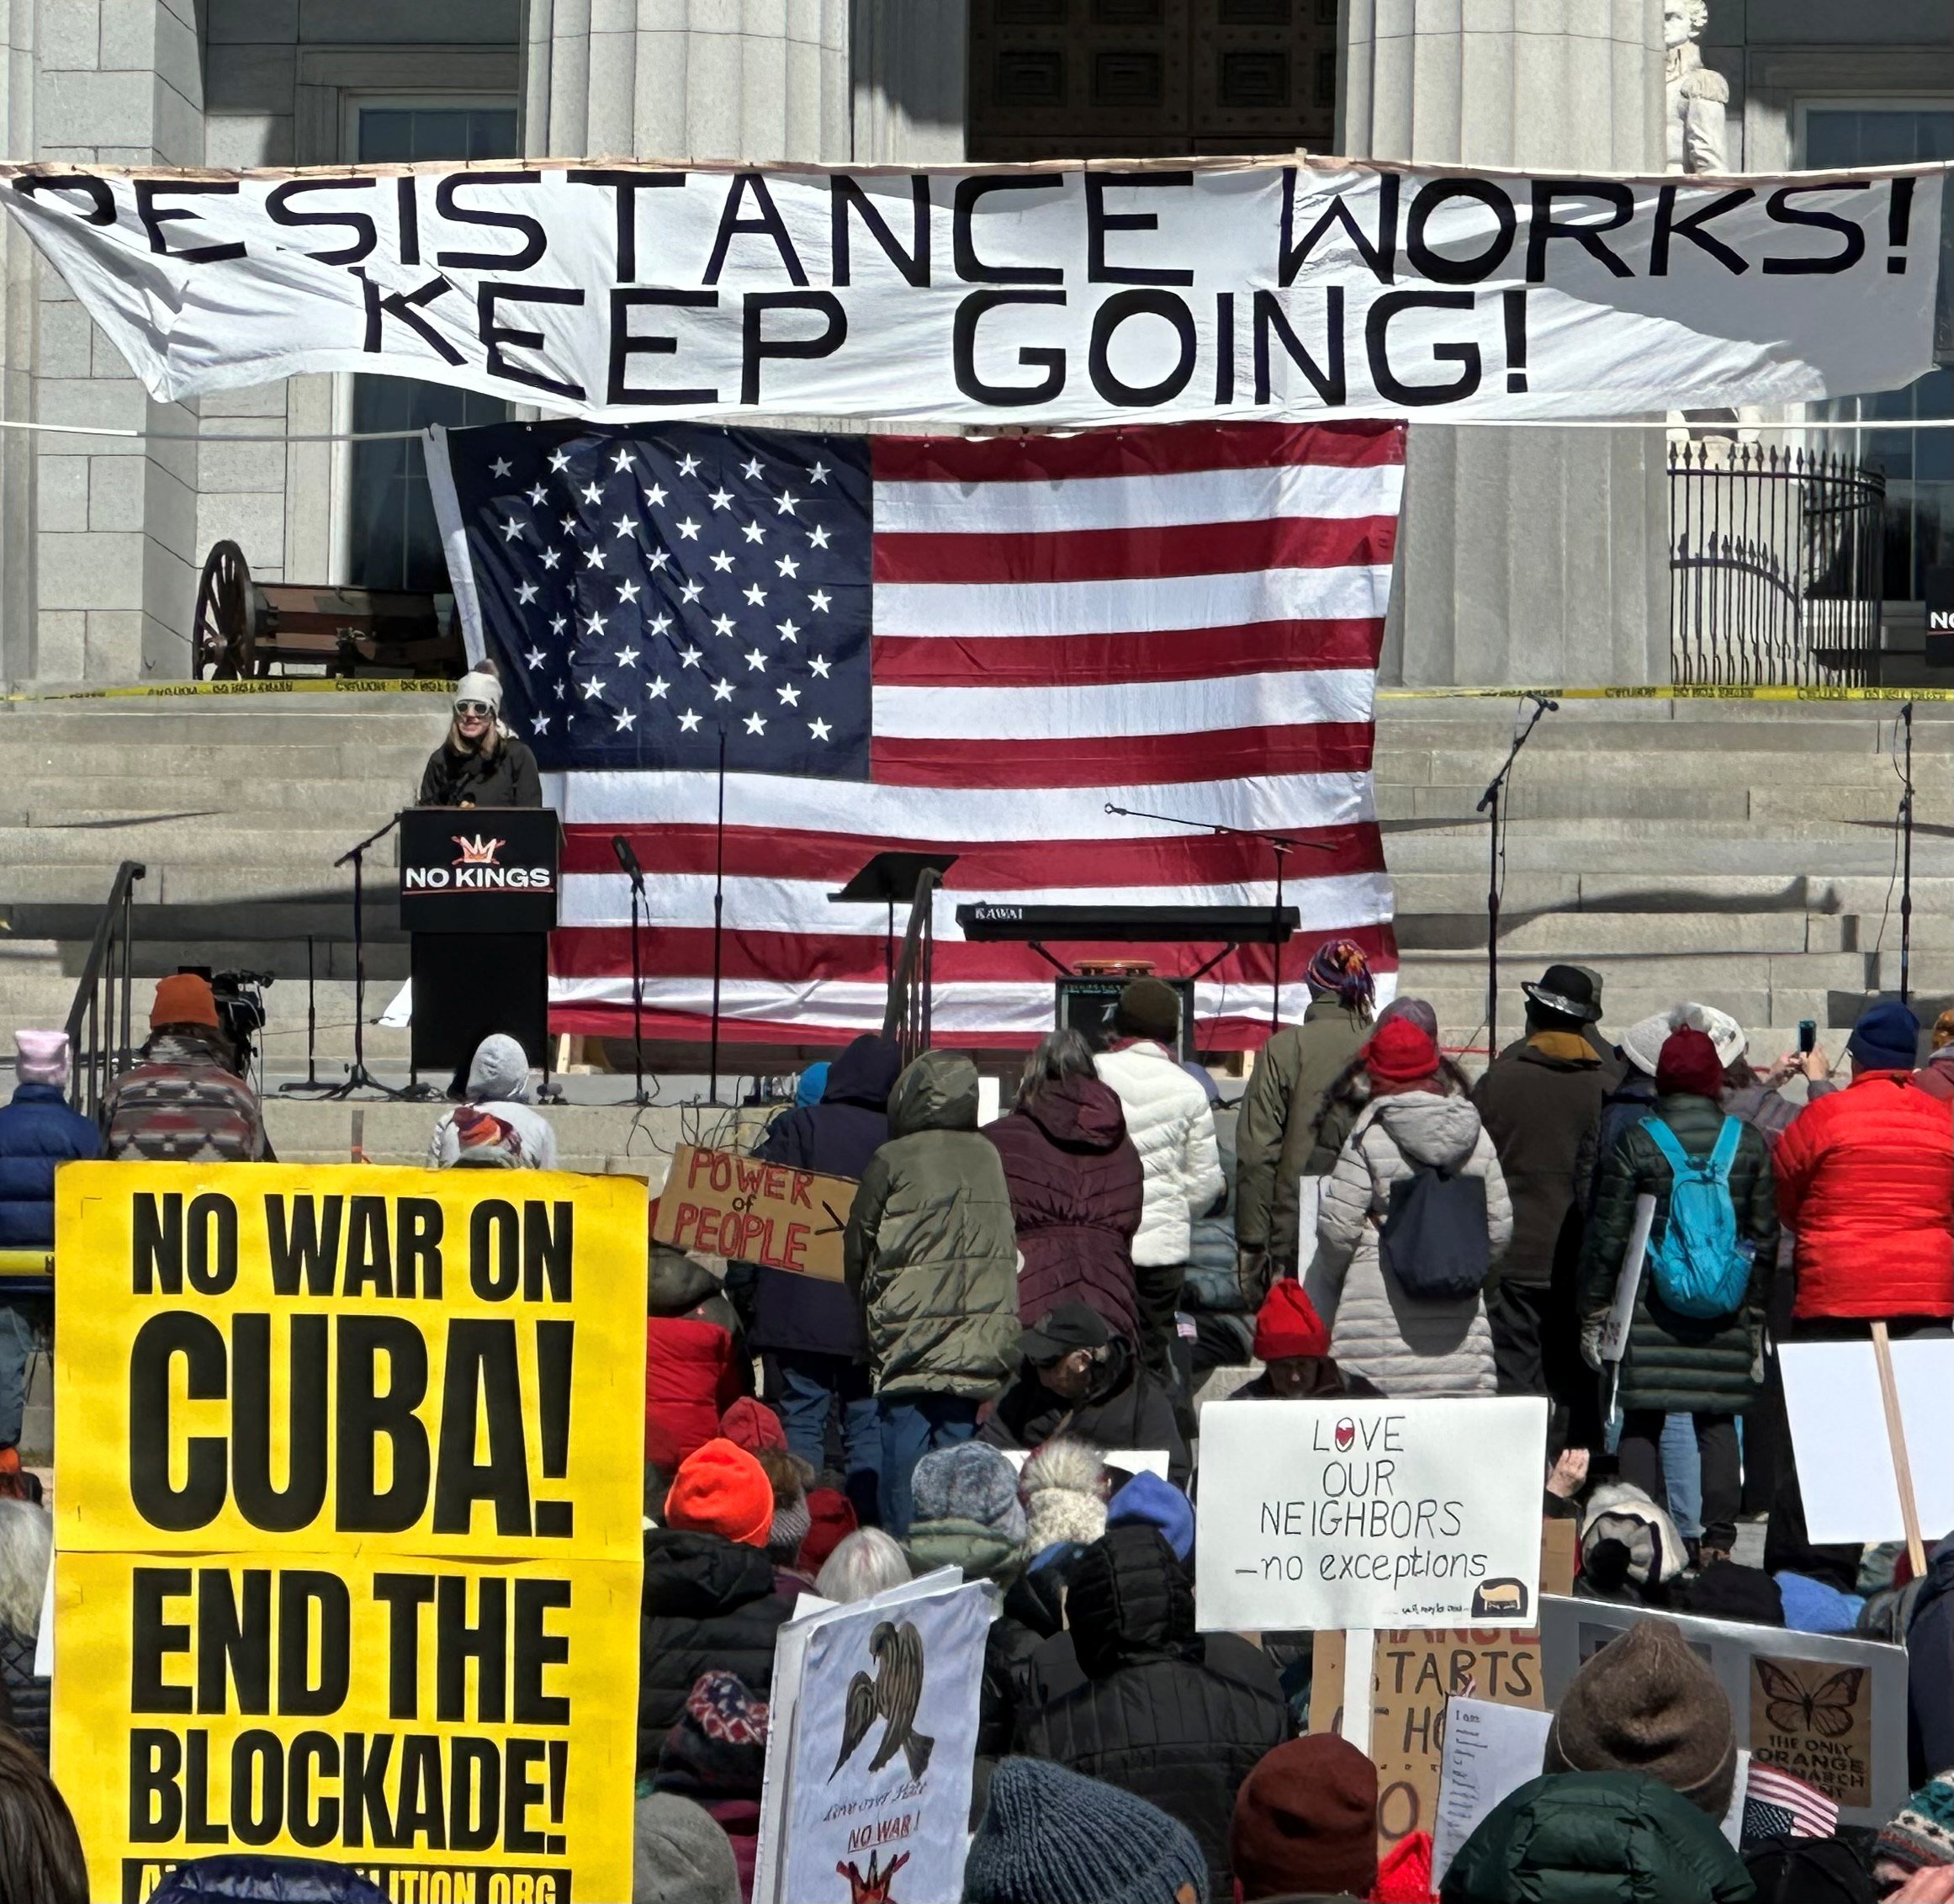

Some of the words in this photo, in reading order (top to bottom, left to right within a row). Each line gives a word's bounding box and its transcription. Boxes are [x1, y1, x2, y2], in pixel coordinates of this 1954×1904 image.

[1279, 168, 1916, 287] WORKS!
[347, 267, 847, 405] KEEP
[953, 283, 1528, 406] GOING!
[1930, 612, 1954, 629] N
[405, 867, 449, 888] NO
[455, 867, 550, 888] KINGS
[976, 908, 1023, 920] KAWAI
[688, 1148, 813, 1209] POWER
[732, 1194, 757, 1213] of
[132, 1192, 238, 1296] NO
[264, 1193, 444, 1300] WAR
[469, 1199, 573, 1303] ON
[673, 1202, 811, 1272] PEOPLE
[129, 1310, 575, 1538] CUBA!
[1312, 1416, 1406, 1453] LOVE
[1323, 1459, 1395, 1498] OUR
[1261, 1500, 1464, 1539] NEIGHBORS
[1319, 1546, 1488, 1590] exceptions
[130, 1567, 351, 1717] END
[373, 1572, 571, 1726] THE
[1374, 1649, 1533, 1697] TARTS
[1755, 1748, 1865, 1774] ORANGE
[1769, 1734, 1799, 1749] THE
[1804, 1739, 1853, 1758] ONLY
[129, 1727, 569, 1855] BLOCKADE!
[848, 1824, 872, 1852] NO
